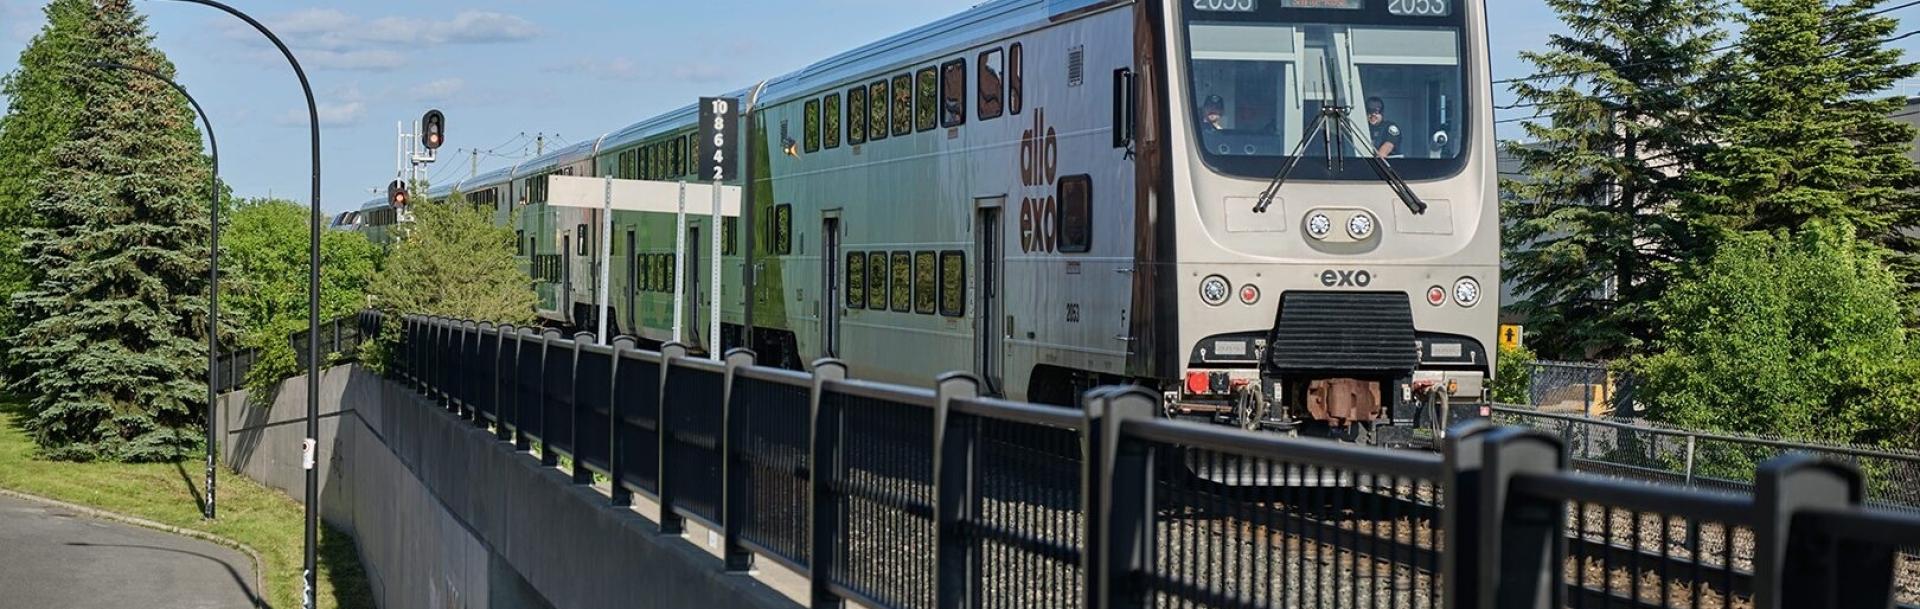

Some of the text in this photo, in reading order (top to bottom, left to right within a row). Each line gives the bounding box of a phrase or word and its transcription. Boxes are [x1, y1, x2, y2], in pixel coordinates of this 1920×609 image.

[711, 101, 728, 114] 10
[713, 116, 724, 130] 8
[713, 133, 724, 147] 6
[1020, 106, 1057, 186] allo
[713, 149, 723, 163] 4
[713, 165, 723, 179] 2
[1020, 195, 1056, 254] exo
[1320, 269, 1371, 288] exo
